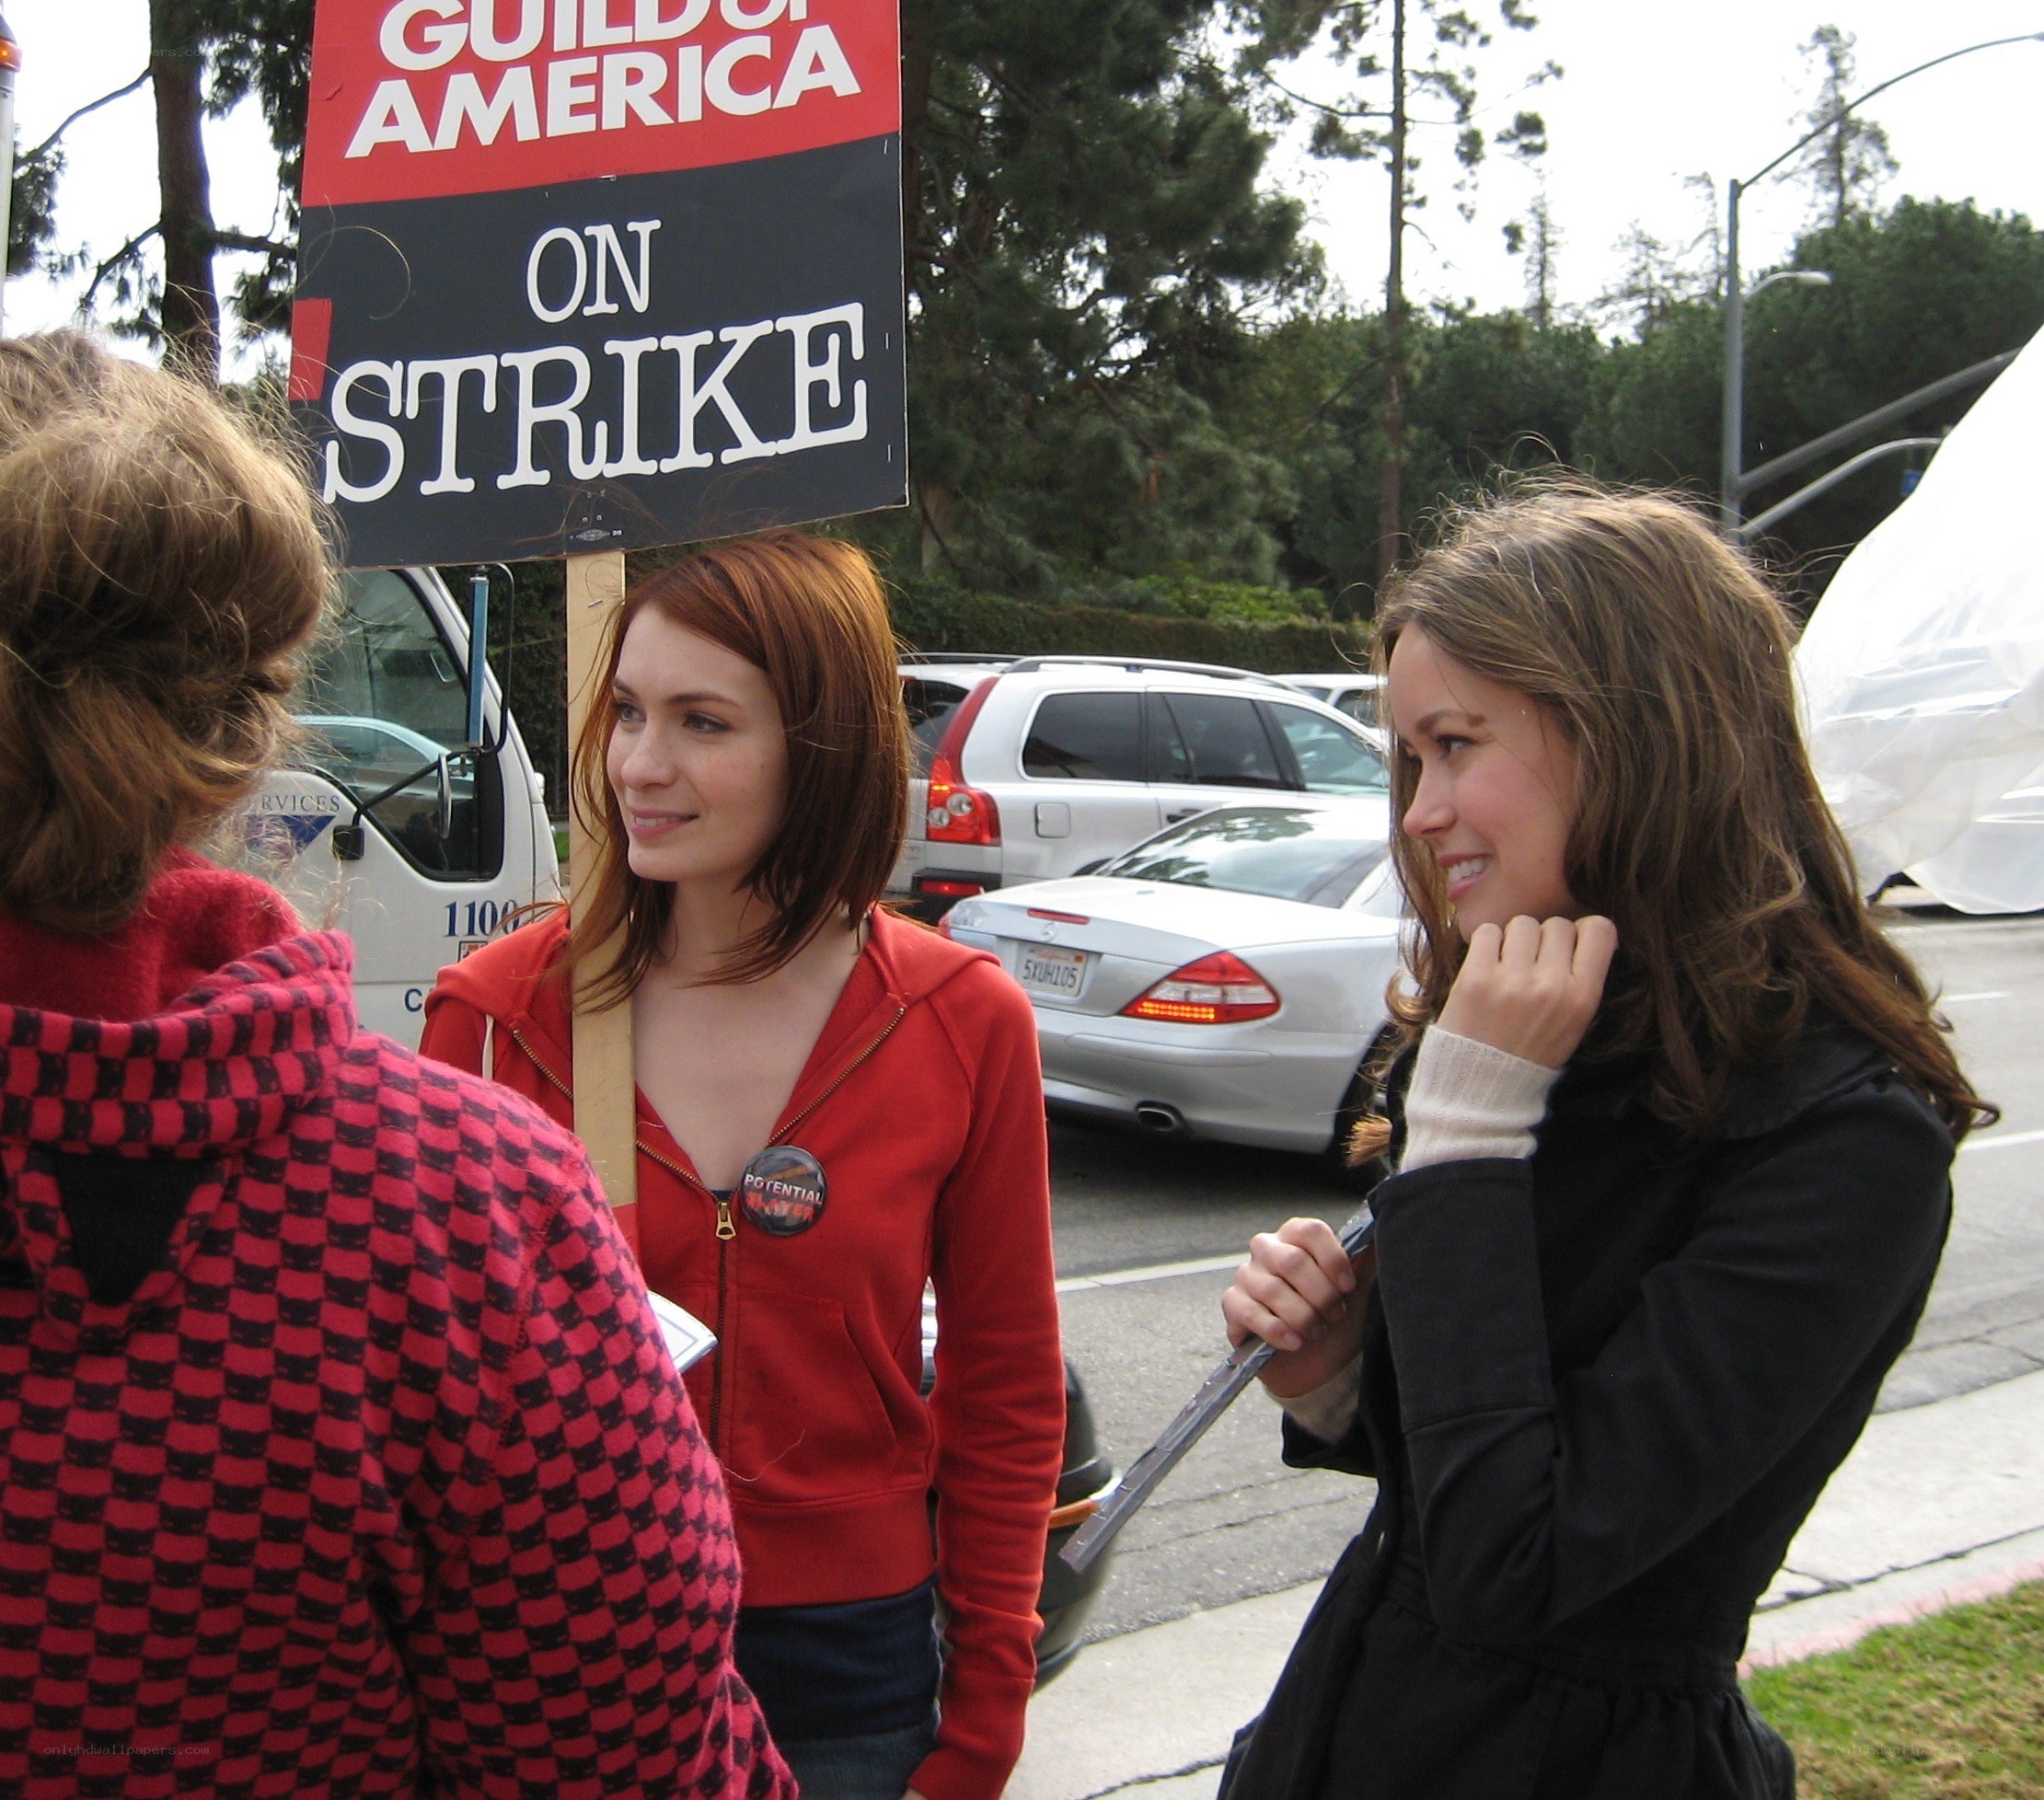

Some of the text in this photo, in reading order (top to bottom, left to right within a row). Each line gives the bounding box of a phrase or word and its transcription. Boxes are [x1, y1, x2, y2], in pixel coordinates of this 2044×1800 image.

[344, 24, 861, 159] AMERICA
[526, 219, 662, 324] ON
[323, 302, 869, 505] STRIKE
[744, 1172, 824, 1206] POTENTIAL
